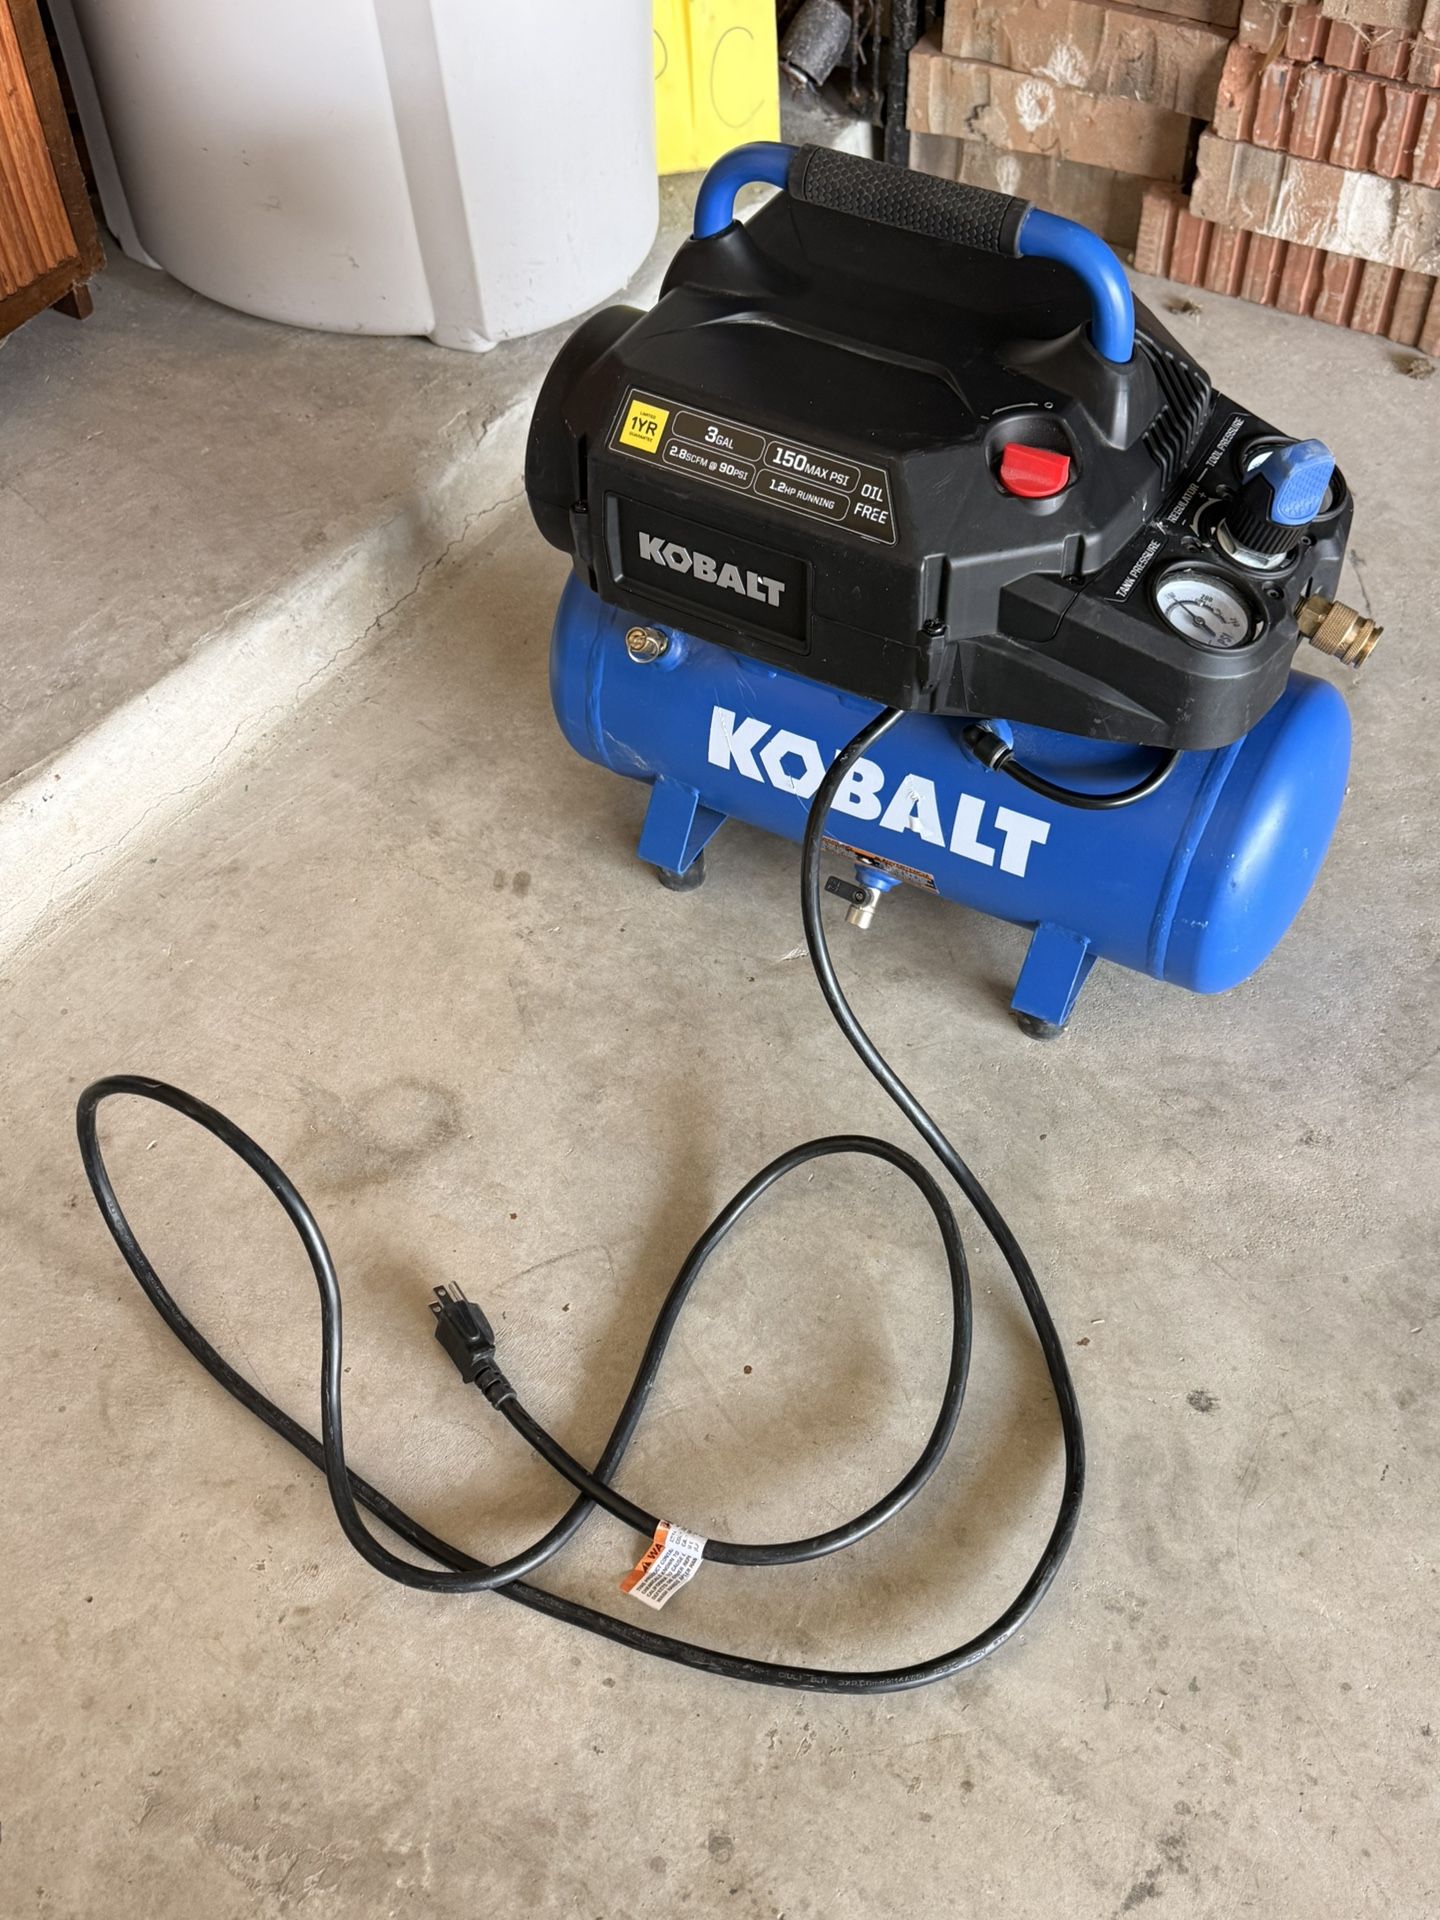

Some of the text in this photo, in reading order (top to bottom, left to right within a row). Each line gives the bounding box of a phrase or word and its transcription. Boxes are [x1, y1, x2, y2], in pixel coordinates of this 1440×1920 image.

[632, 416, 658, 437] 1YR
[1205, 416, 1245, 467] TOOL PRESSURE
[829, 471, 850, 486] PSI
[861, 484, 883, 502] OIL
[796, 490, 835, 510] RUNNING
[854, 502, 888, 524] FREE
[1167, 482, 1200, 523] REGULATOR
[638, 531, 785, 607] KOBALT
[1115, 539, 1161, 598] TANK PRESSURE
[708, 705, 1050, 878] KOBALT
